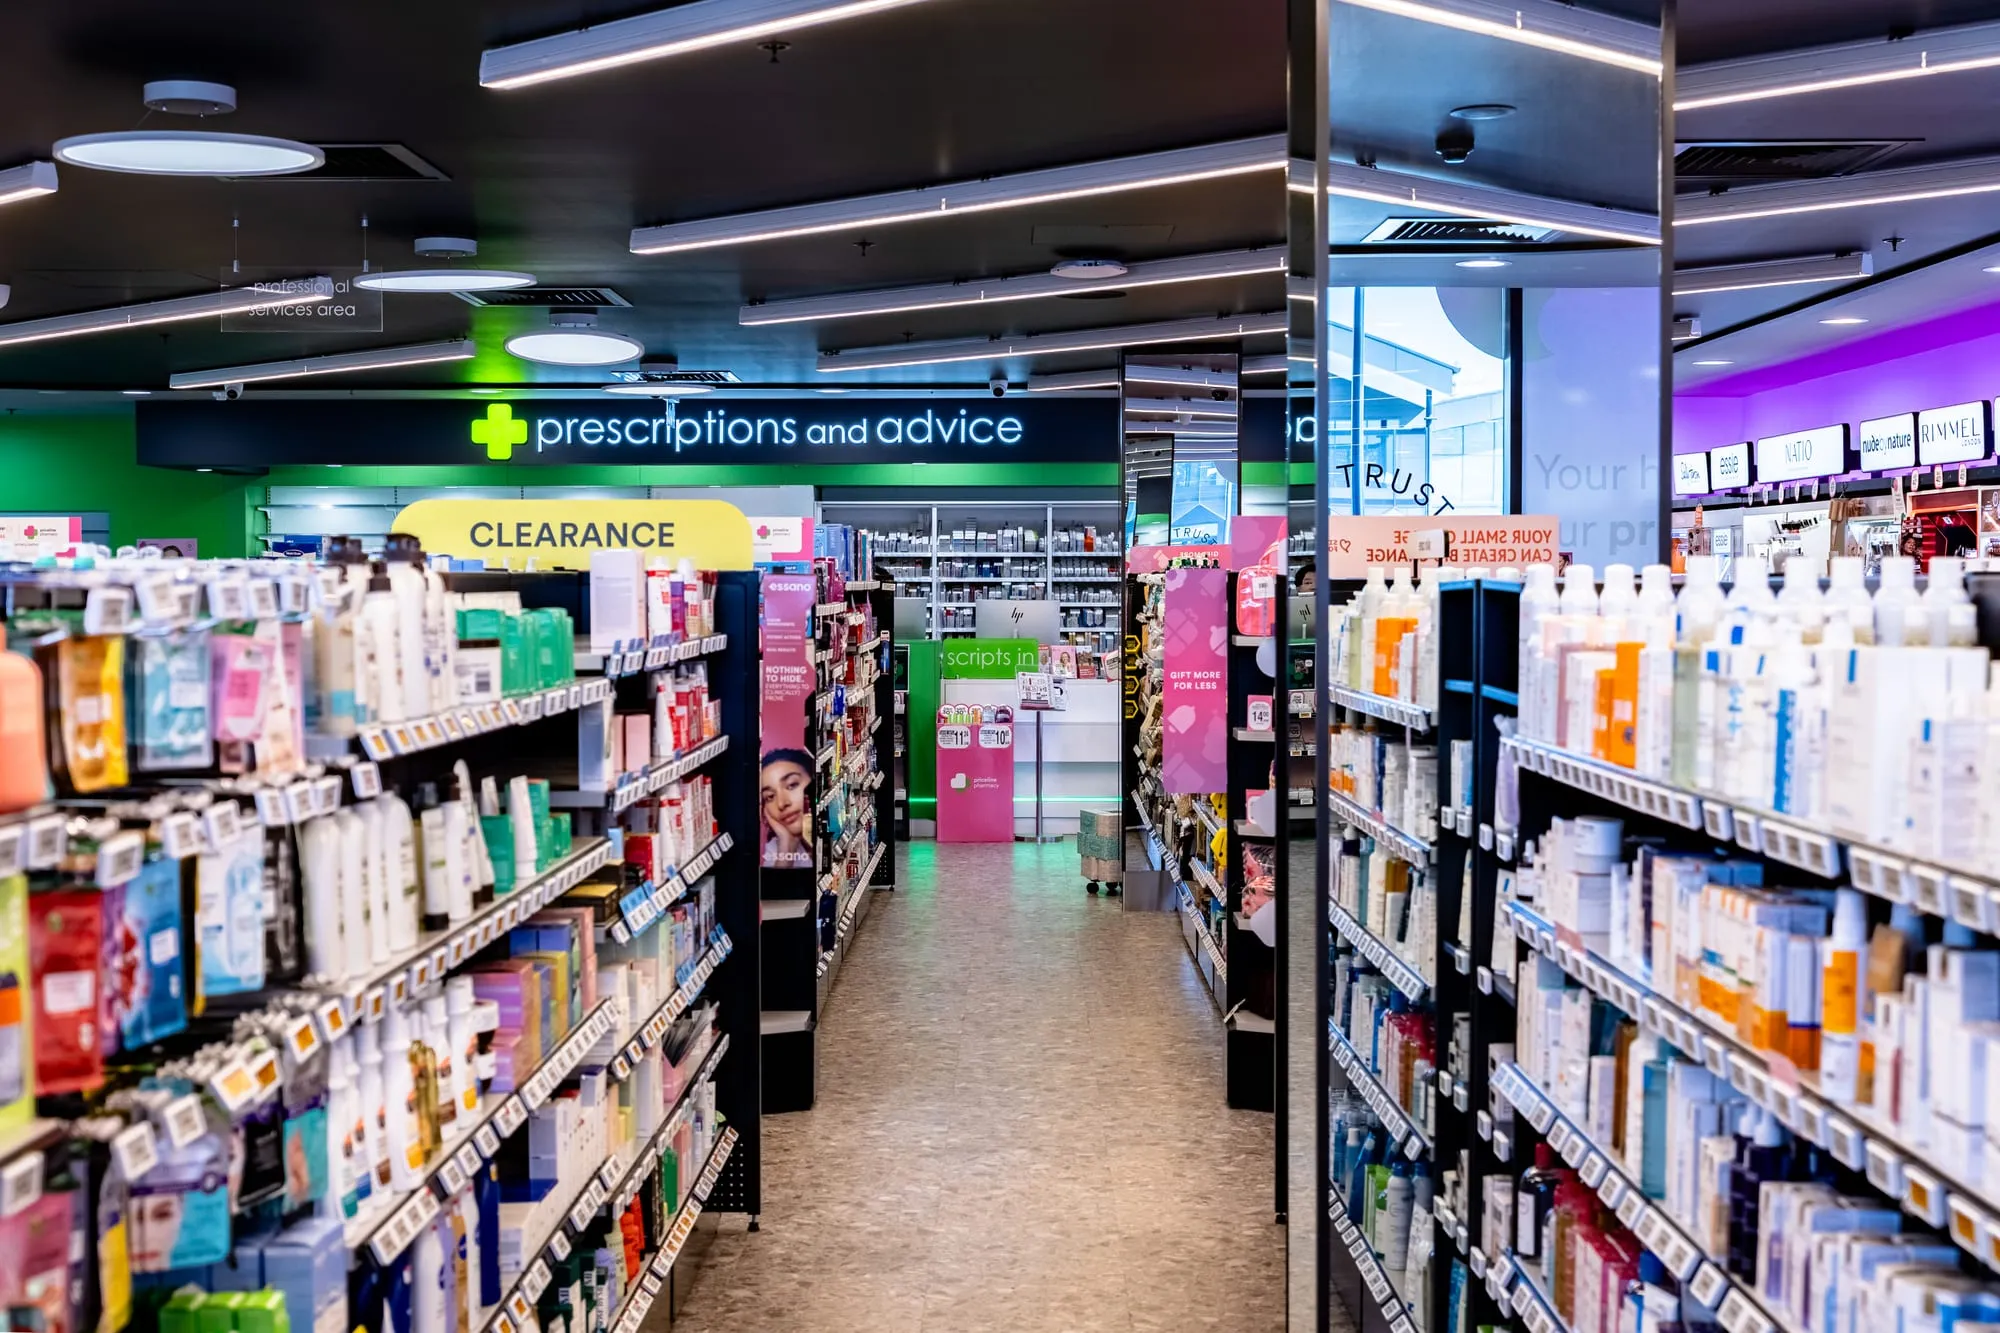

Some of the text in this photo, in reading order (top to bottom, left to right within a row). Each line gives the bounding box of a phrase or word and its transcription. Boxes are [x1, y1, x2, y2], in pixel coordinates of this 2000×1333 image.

[254, 279, 350, 296] professional
[248, 304, 356, 317] services area
[537, 409, 1023, 453] prescriptions and advice
[1922, 417, 1981, 443] RIMMEL
[1784, 439, 1813, 464] NATIO
[1534, 453, 1627, 490] Your
[1720, 453, 1739, 475] essie
[1335, 463, 1455, 516] TRUST
[470, 522, 675, 548] CLEARANCE
[1559, 521, 1597, 547] ur
[768, 582, 811, 592] essano
[946, 648, 1034, 667] scripts in
[765, 666, 808, 674] NOTHING
[1170, 671, 1221, 680] GIFT MORE
[1174, 681, 1217, 691] FOR LESS
[1252, 711, 1263, 722] 14
